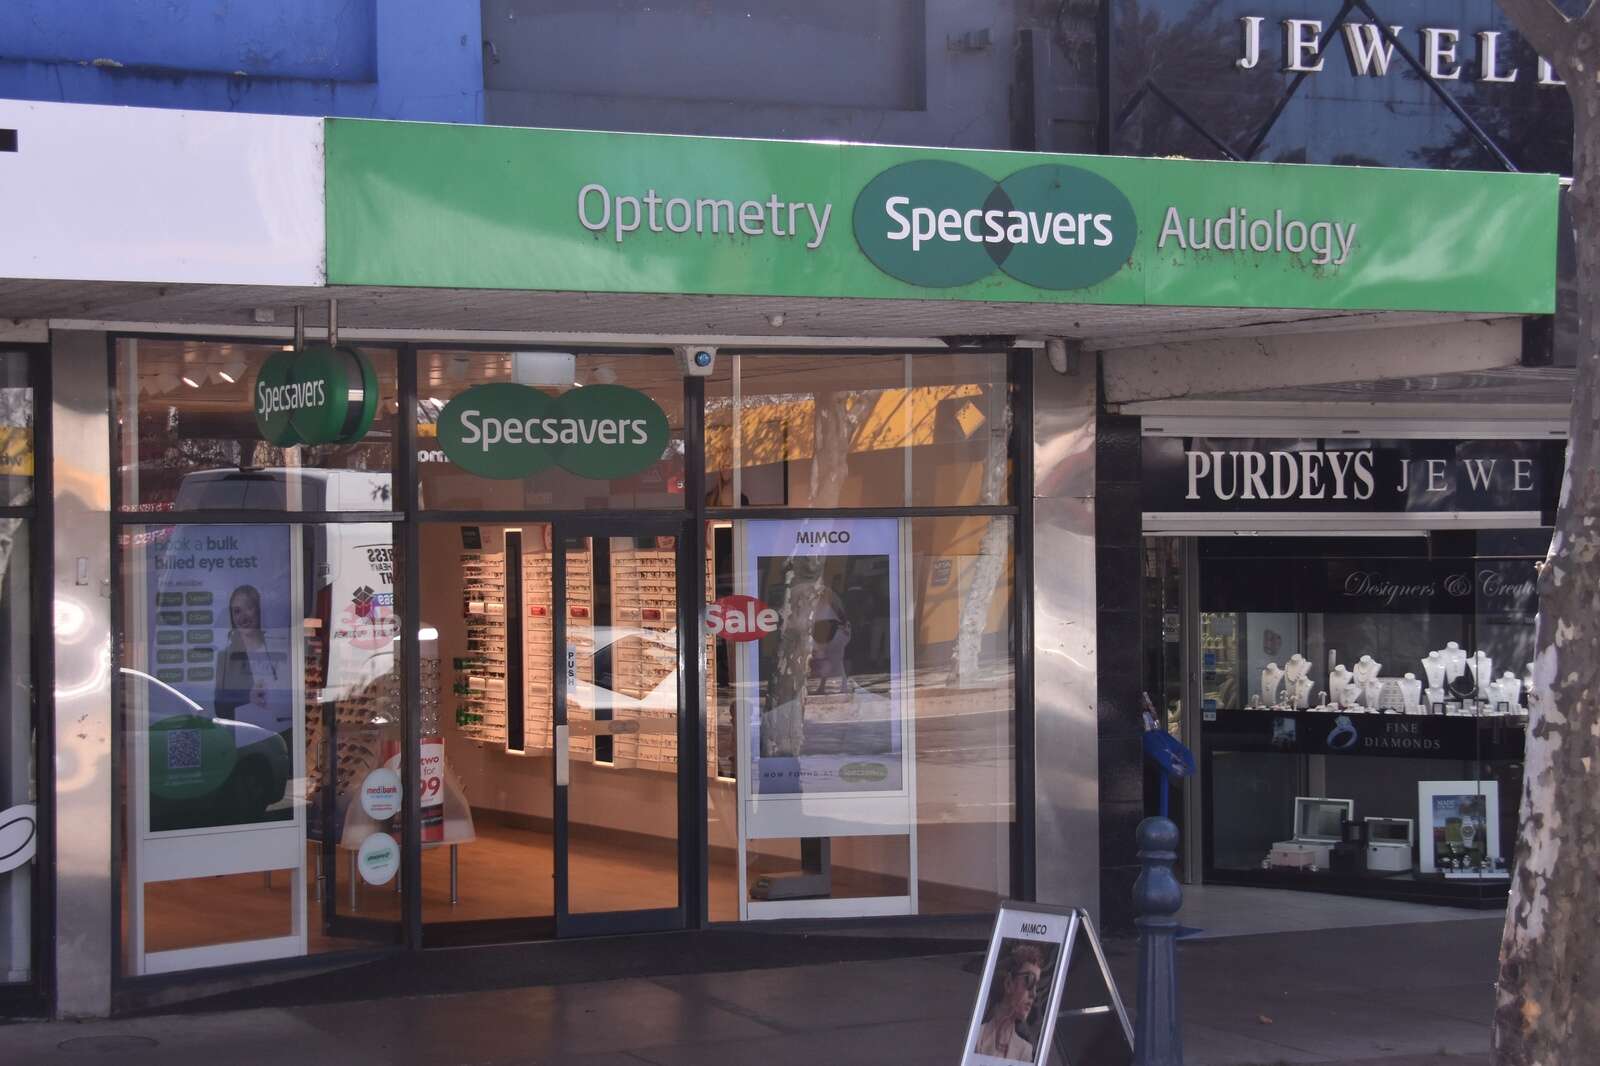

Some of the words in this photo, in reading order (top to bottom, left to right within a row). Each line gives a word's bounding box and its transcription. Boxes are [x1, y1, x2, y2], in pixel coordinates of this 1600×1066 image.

[577, 183, 832, 249] Optometry
[885, 196, 1113, 252] Specsavers
[1158, 206, 1357, 265] Audiology
[259, 379, 325, 421] Specsavers
[460, 410, 648, 452] Specsavers
[1185, 450, 1375, 500] PURDEYS
[206, 536, 239, 550] bulk
[796, 531, 850, 547] MIMCO
[199, 558, 224, 572] eye
[228, 556, 258, 568] test
[1344, 570, 1436, 604] Designers
[1443, 574, 1472, 597] &
[704, 601, 780, 635] Sale
[1364, 737, 1441, 749] DIAMONDS
[1386, 723, 1418, 734] FINE
